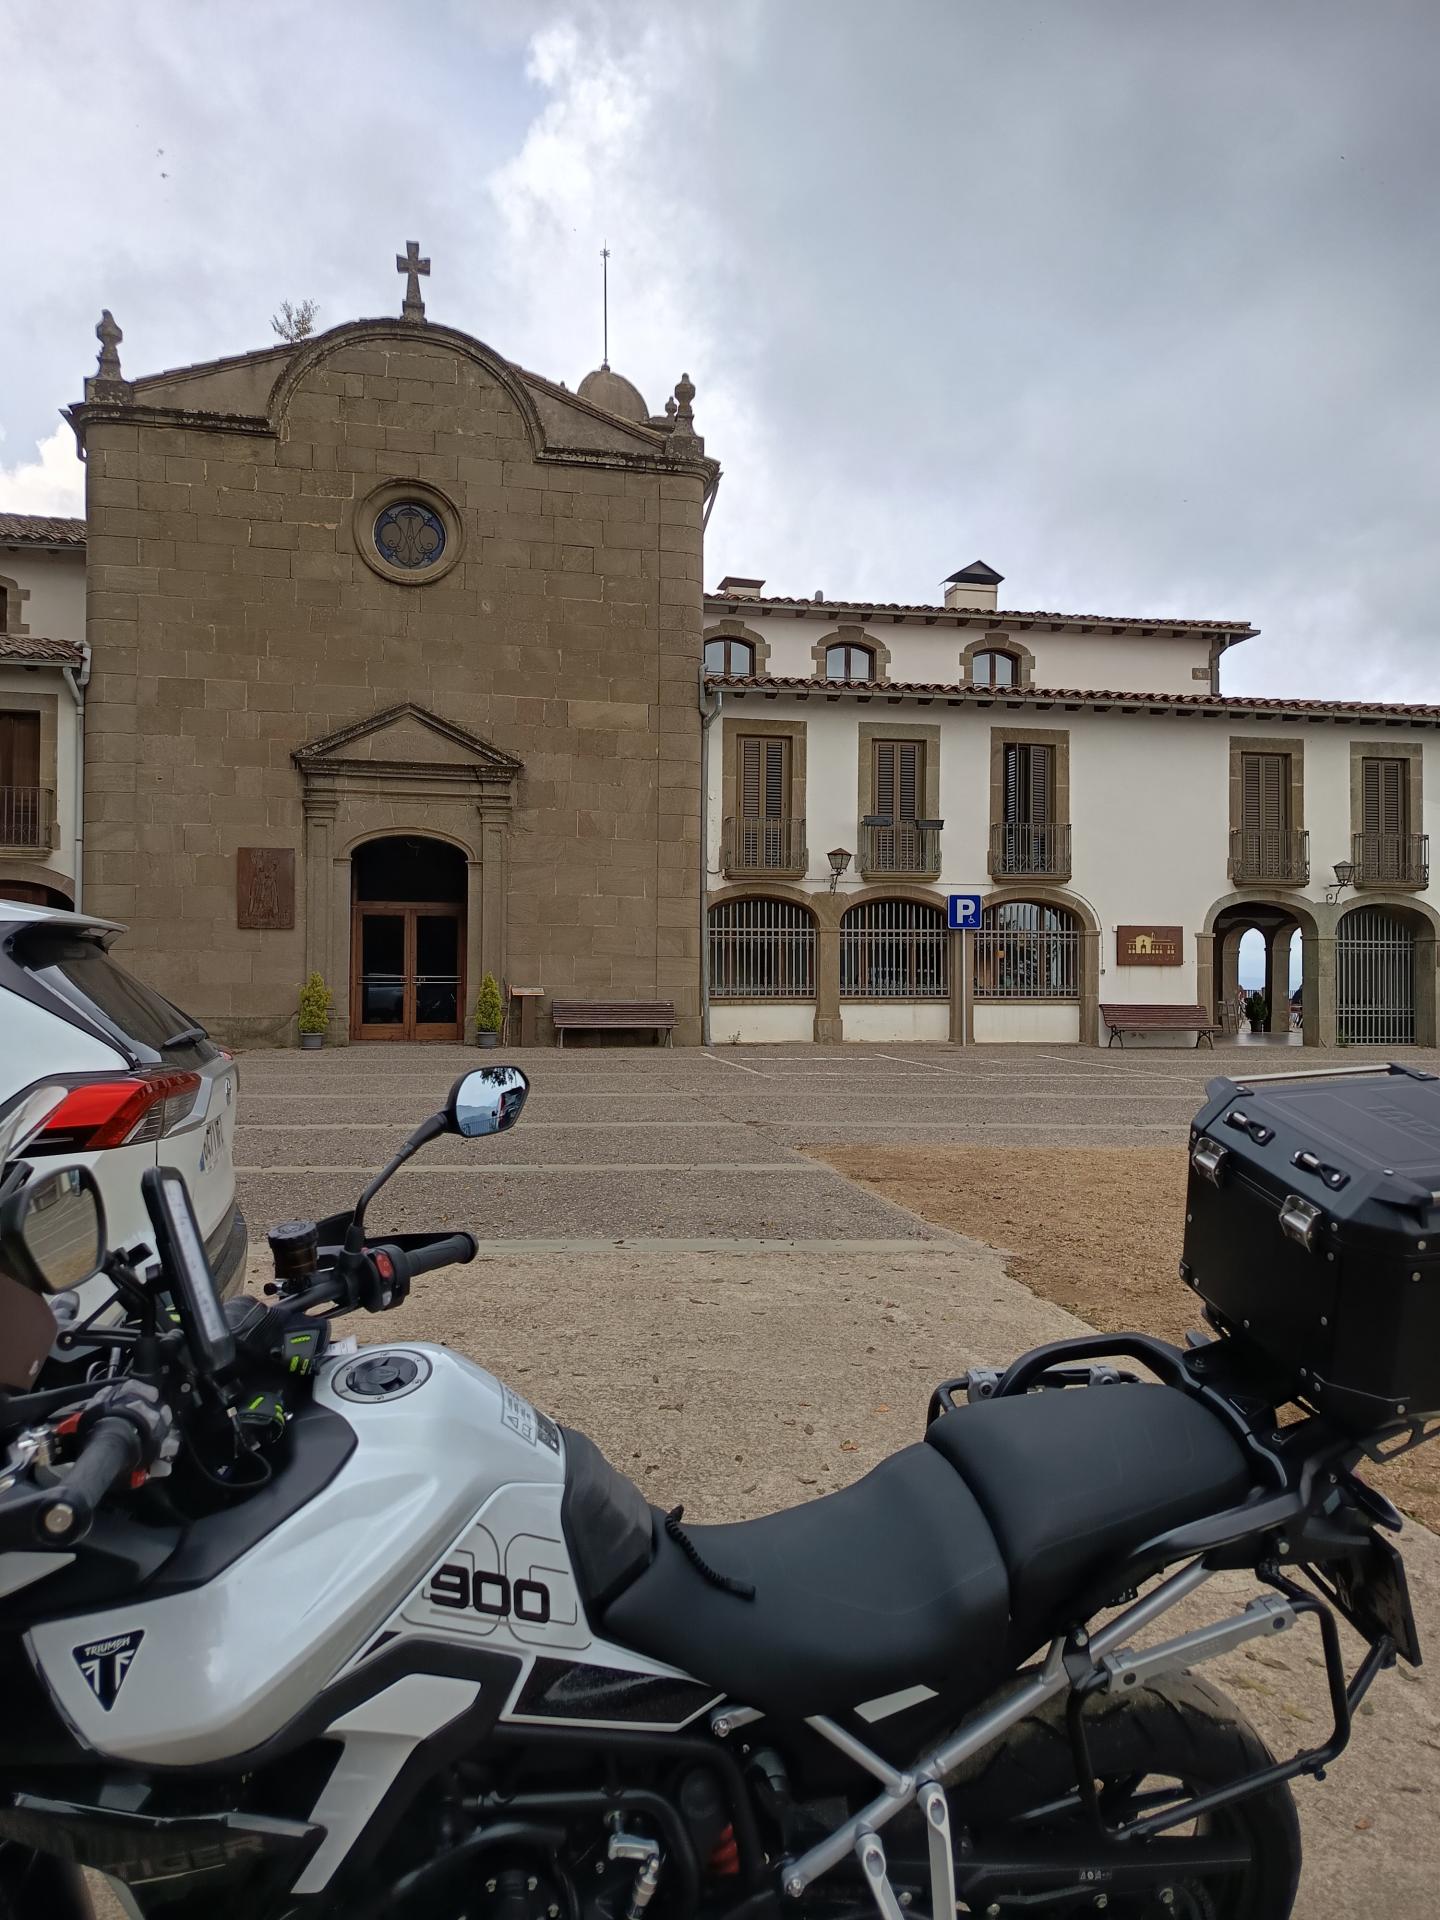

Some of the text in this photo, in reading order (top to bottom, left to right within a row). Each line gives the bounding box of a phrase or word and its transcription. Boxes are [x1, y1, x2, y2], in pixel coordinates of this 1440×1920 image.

[956, 899, 976, 924] P
[430, 1564, 550, 1624] 900
[84, 1636, 131, 1656] TRIUMPH
[102, 1834, 265, 1880] TIGER
